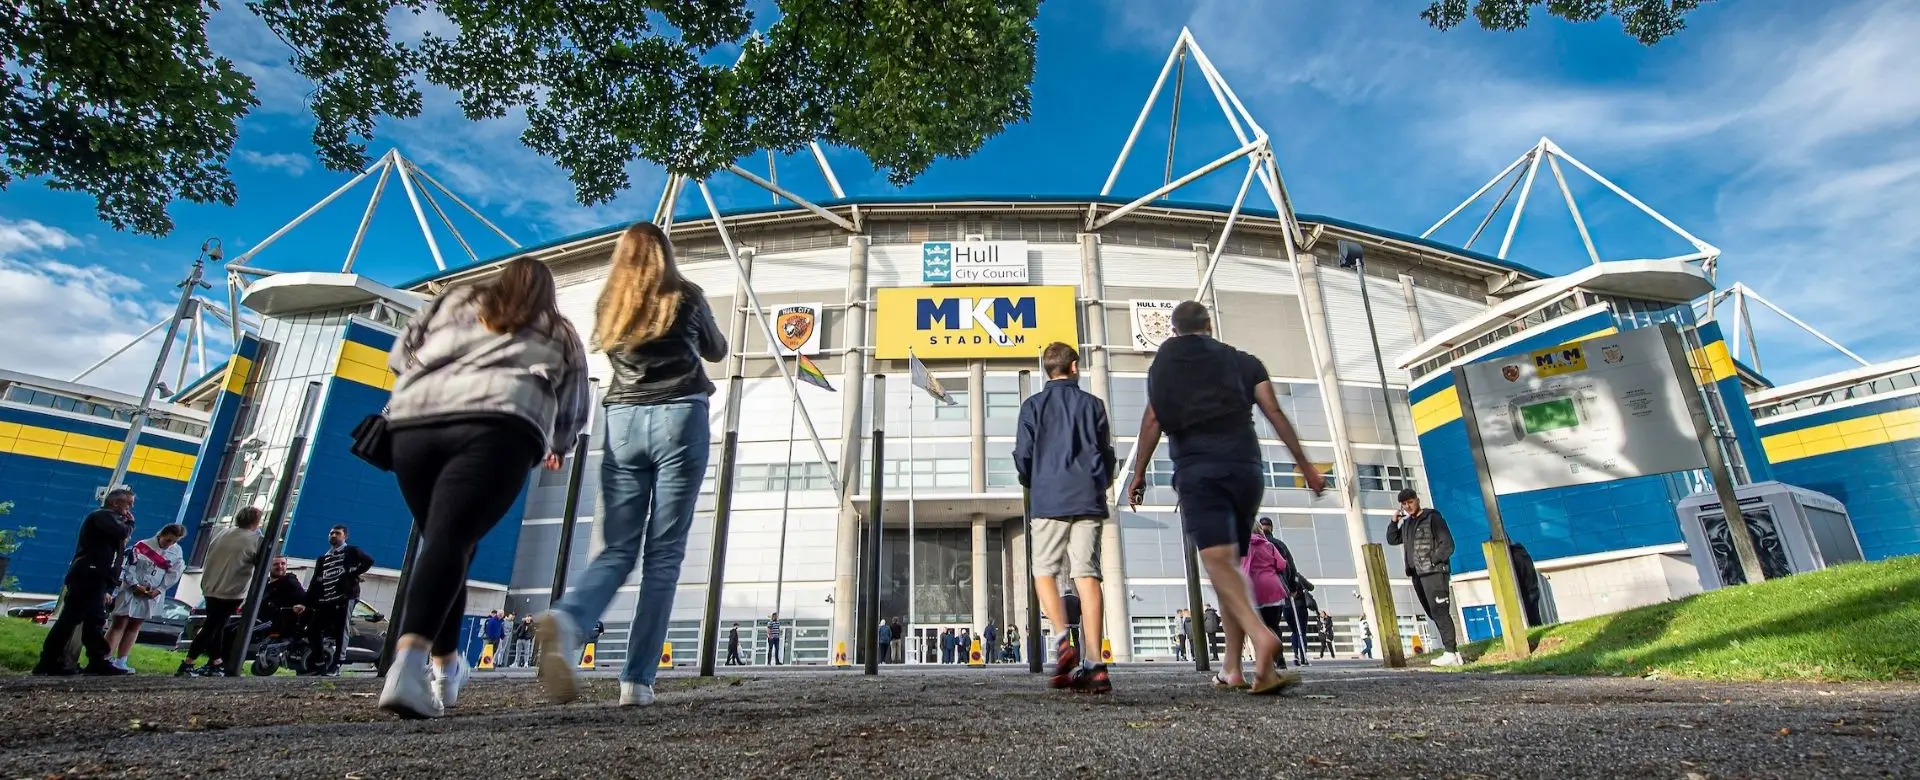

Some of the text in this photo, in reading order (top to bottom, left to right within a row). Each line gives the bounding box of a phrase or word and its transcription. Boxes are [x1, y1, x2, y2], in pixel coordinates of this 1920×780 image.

[955, 245, 999, 262] Hull
[955, 267, 1026, 279] City Council
[917, 296, 1037, 347] MKM
[929, 334, 1025, 345] STADIUM
[1535, 348, 1580, 367] MKM
